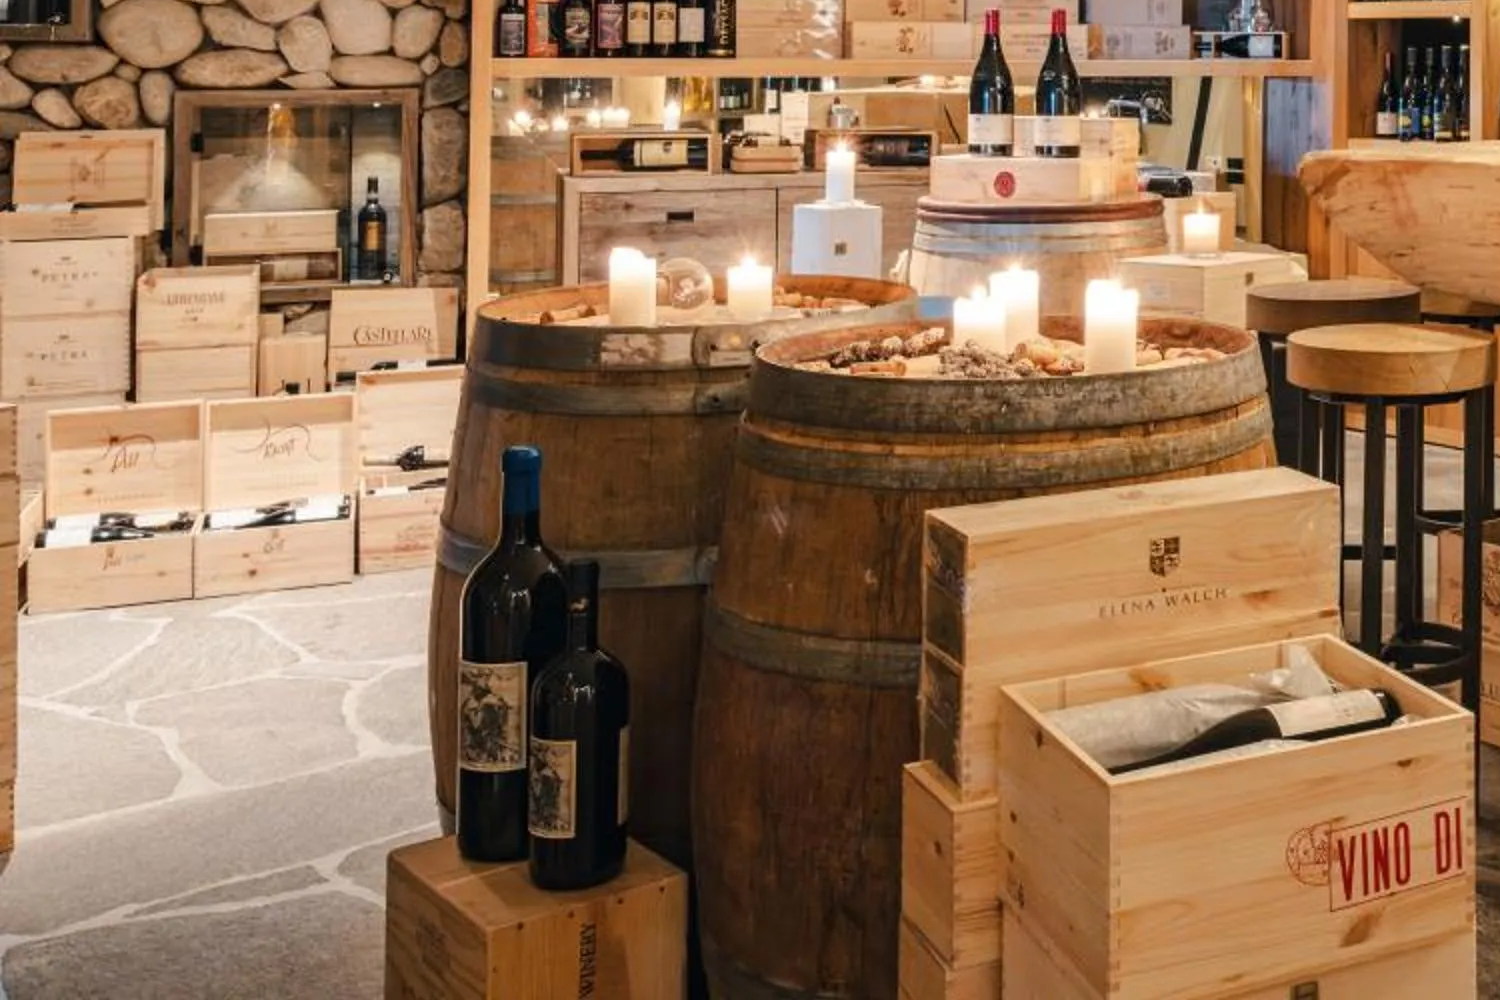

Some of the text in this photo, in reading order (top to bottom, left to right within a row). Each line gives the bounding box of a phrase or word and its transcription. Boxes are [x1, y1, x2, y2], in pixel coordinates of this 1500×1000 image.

[1338, 807, 1462, 901] VINO DI
[577, 921, 597, 999] WINERY
